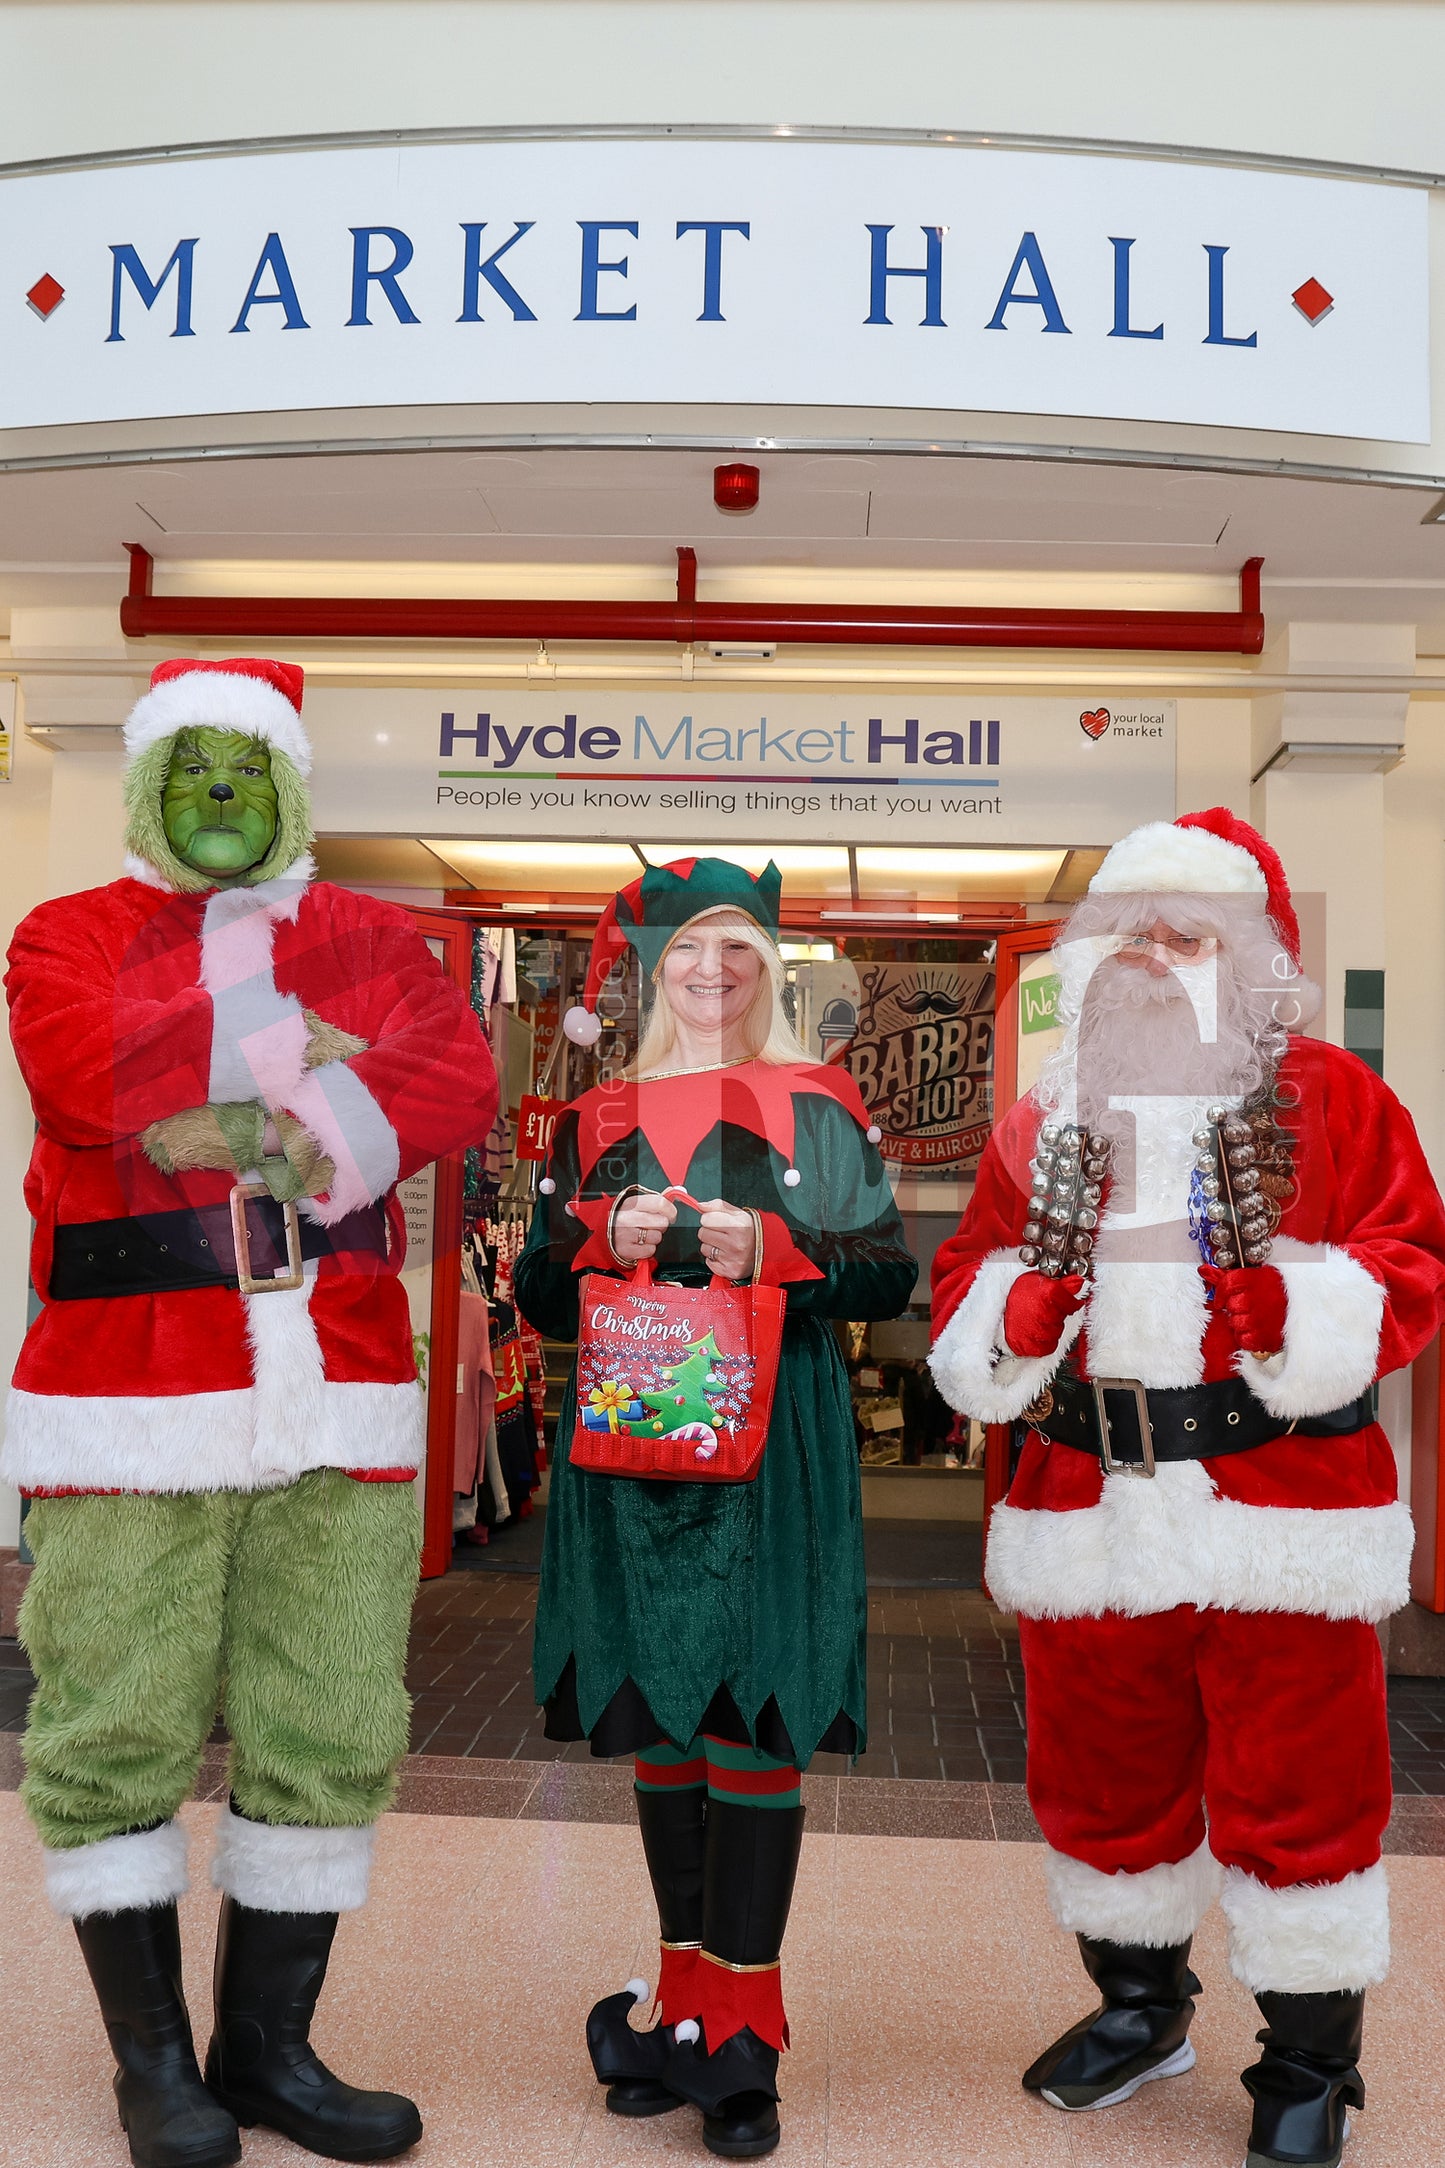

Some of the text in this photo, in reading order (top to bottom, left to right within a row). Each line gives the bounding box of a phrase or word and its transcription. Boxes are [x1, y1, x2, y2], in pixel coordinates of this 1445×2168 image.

[104, 221, 1258, 348] MARKET HALL
[1113, 713, 1165, 724] your local
[439, 712, 1000, 769] Hyde Market Hall
[1113, 725, 1163, 738] market
[436, 786, 1002, 817] People you know selling things that you want
[890, 1076, 972, 1129] SHOP
[525, 1112, 556, 1150] £10
[910, 1142, 922, 1159] &
[403, 1191, 428, 1200] 5:00pm
[403, 1206, 428, 1215] 5:00pm
[411, 1237, 426, 1245] DAY
[626, 1295, 668, 1314] Merry
[591, 1303, 696, 1343] Christmas
